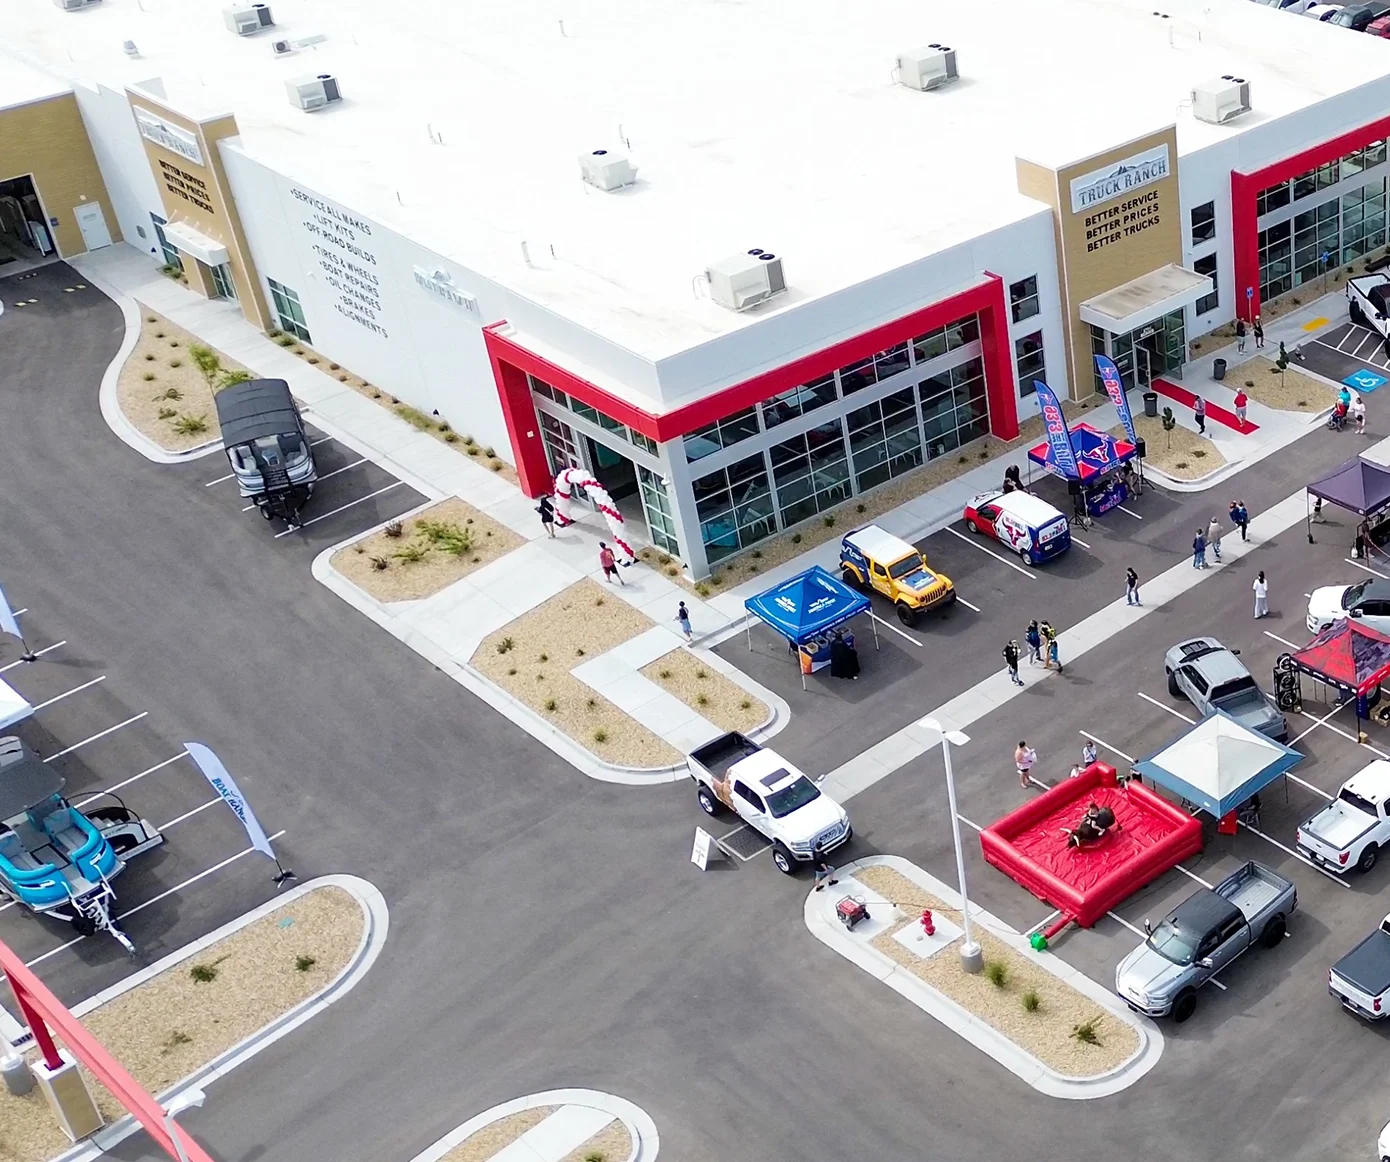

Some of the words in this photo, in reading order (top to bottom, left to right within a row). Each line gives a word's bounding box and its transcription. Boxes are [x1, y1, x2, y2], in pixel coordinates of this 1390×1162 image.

[1078, 178, 1121, 206] TRUCK
[1124, 159, 1167, 188] RANCH
[293, 188, 326, 212] SERVICE
[327, 206, 342, 221] ALL
[342, 213, 372, 235] MAKES
[317, 213, 333, 229] LIFT
[335, 223, 355, 241] KITS
[1085, 206, 1120, 227] BETTER
[1121, 190, 1158, 213] SERVICE
[1086, 219, 1121, 240] BETTER
[1123, 203, 1159, 224] PRICES
[1087, 231, 1121, 253] BETTER
[1124, 215, 1160, 236] TRUCKS
[315, 244, 339, 265] TIRES
[346, 261, 379, 285] WHEELS
[346, 242, 376, 265] BUILDS
[322, 260, 343, 278] BOAT
[344, 273, 379, 298] REPAIRS
[328, 276, 342, 290] OIL
[343, 284, 381, 311] CHANGES
[338, 304, 388, 338] ALIGNMENTS
[342, 295, 375, 320] BRAKES
[212, 778, 231, 798] BOAT
